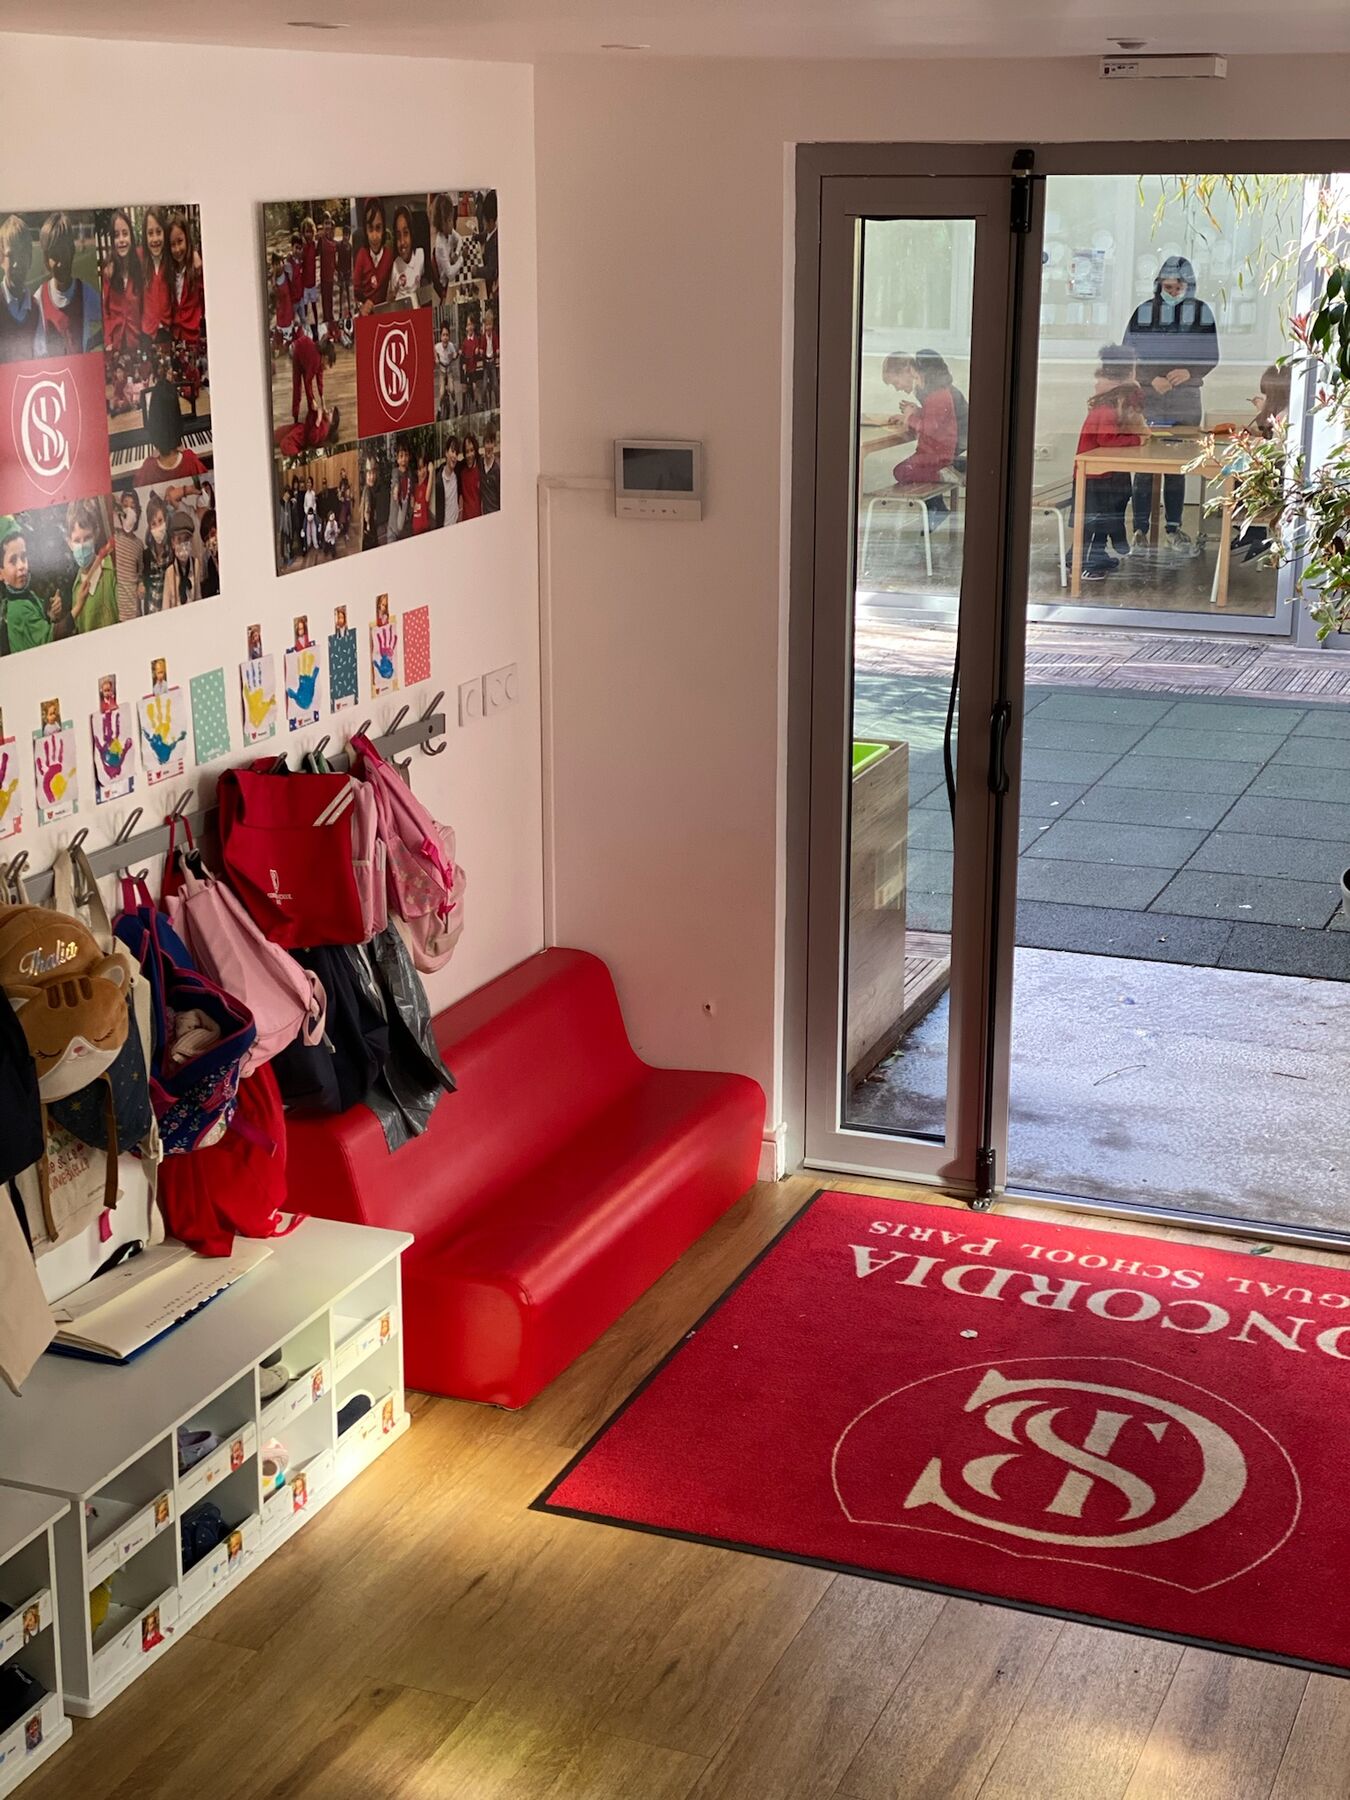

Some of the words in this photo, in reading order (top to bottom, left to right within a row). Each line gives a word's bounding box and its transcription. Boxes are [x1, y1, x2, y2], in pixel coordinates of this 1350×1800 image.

[19, 939, 78, 979] Thalia
[868, 1220, 1002, 1257] PARIS
[1020, 1243, 1204, 1290] SCHOOL
